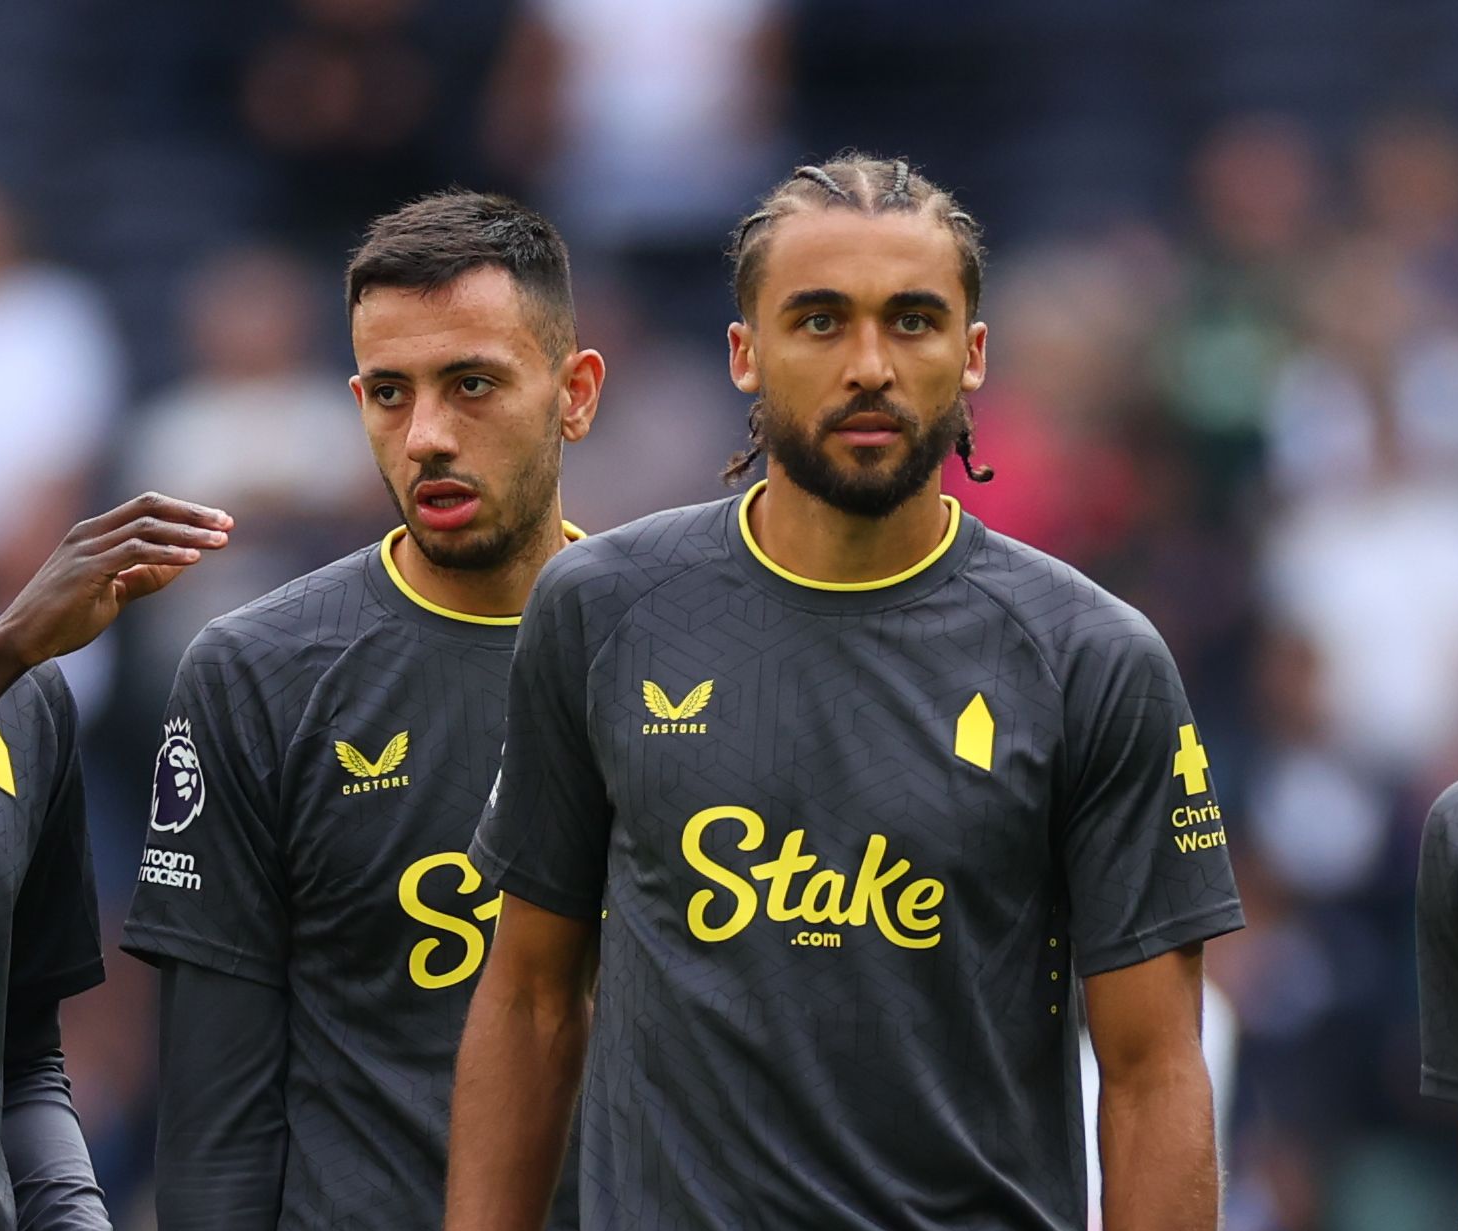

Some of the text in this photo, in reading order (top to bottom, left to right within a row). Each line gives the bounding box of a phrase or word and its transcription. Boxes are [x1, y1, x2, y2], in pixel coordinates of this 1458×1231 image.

[642, 723, 707, 735] CASTORE
[342, 774, 410, 796] CASTORE
[1173, 825, 1227, 854] Ward
[145, 848, 195, 871] room
[141, 865, 202, 890] racism
[681, 805, 946, 949] Stake
[790, 930, 842, 948] .com
